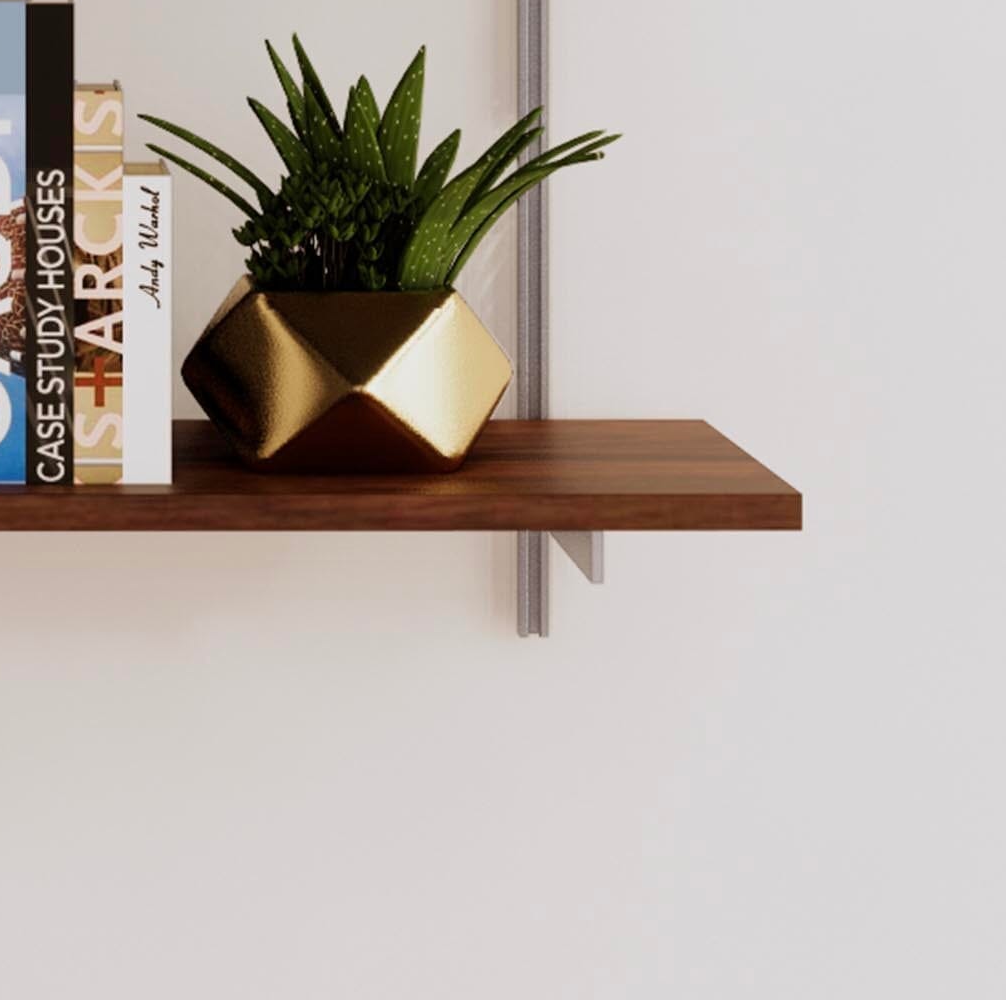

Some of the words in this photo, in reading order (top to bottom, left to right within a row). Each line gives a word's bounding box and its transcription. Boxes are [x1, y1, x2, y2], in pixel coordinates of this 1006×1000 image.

[36, 169, 66, 290] HOUSES
[138, 186, 160, 250] Warhol
[138, 259, 165, 310] Andy
[36, 296, 66, 395] STUDY
[36, 403, 66, 483] CASE
